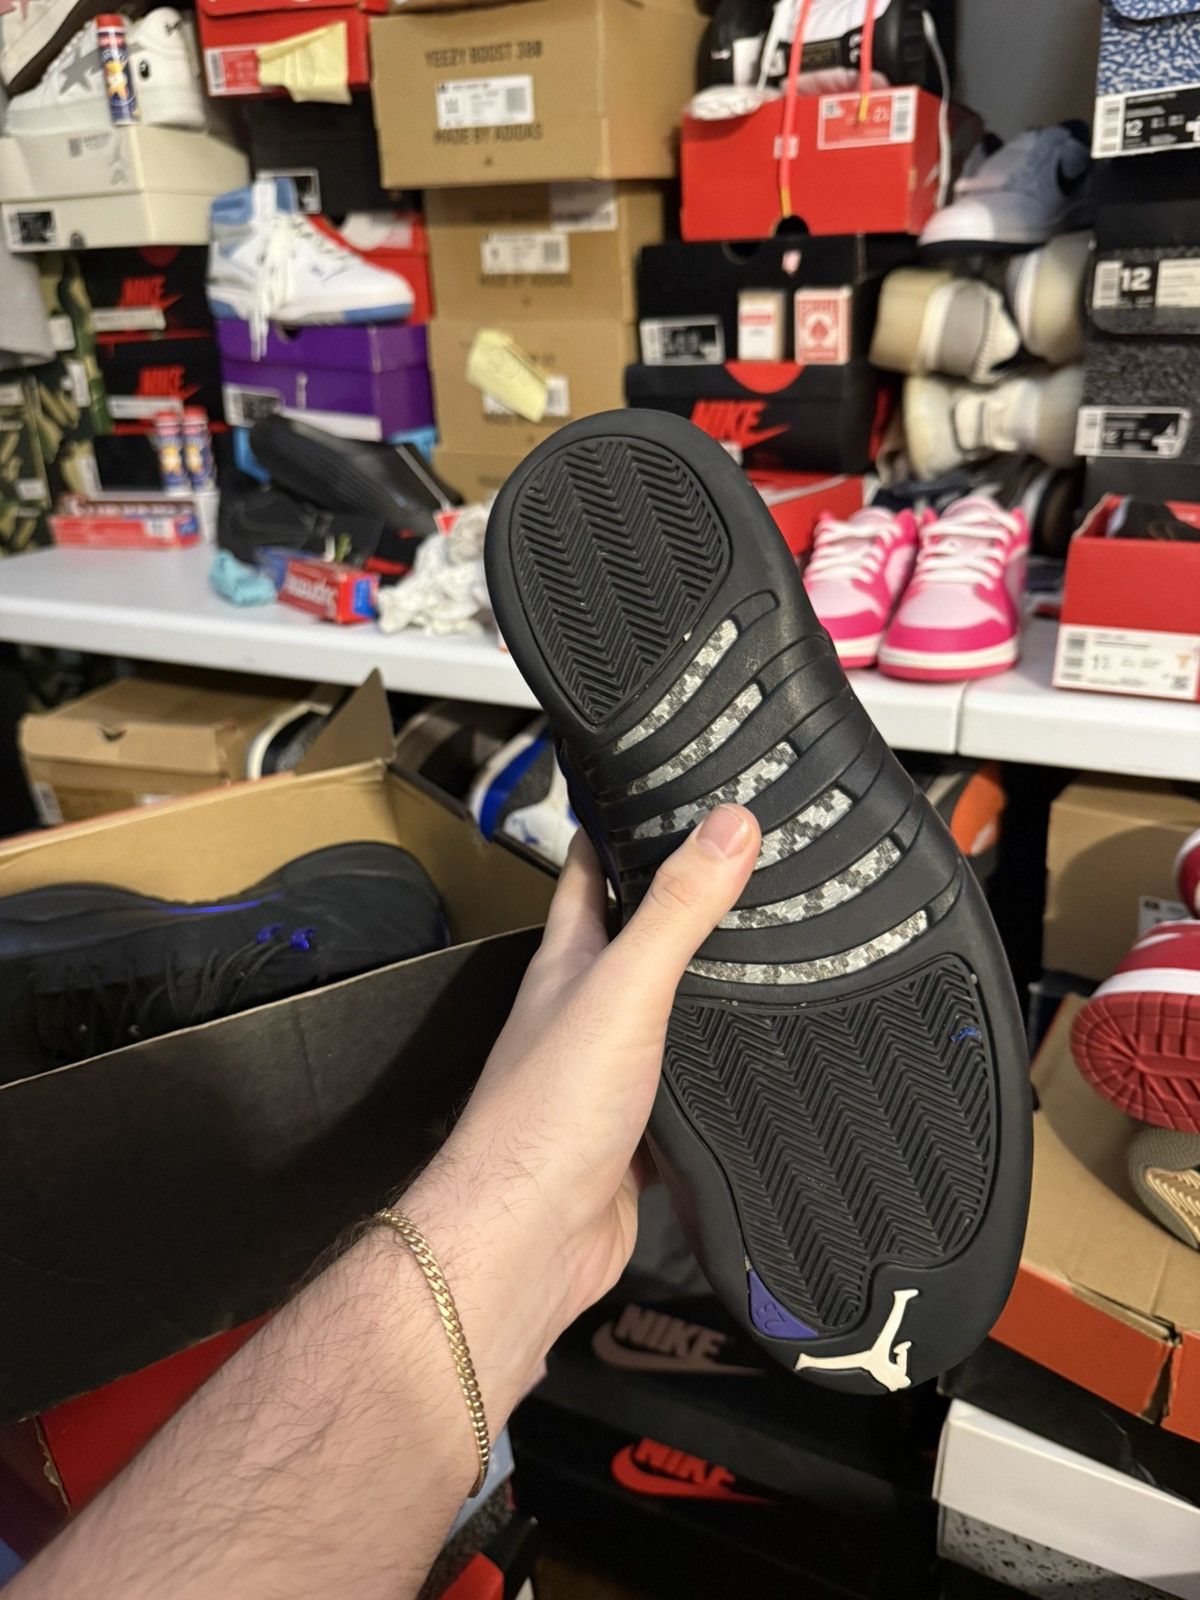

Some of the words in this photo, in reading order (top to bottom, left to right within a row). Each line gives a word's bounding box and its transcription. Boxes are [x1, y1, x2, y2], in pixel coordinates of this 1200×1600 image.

[1125, 119, 1143, 137] 12
[1120, 266, 1152, 292] 12
[690, 399, 766, 442] NIKE
[612, 1302, 728, 1360] NIKE
